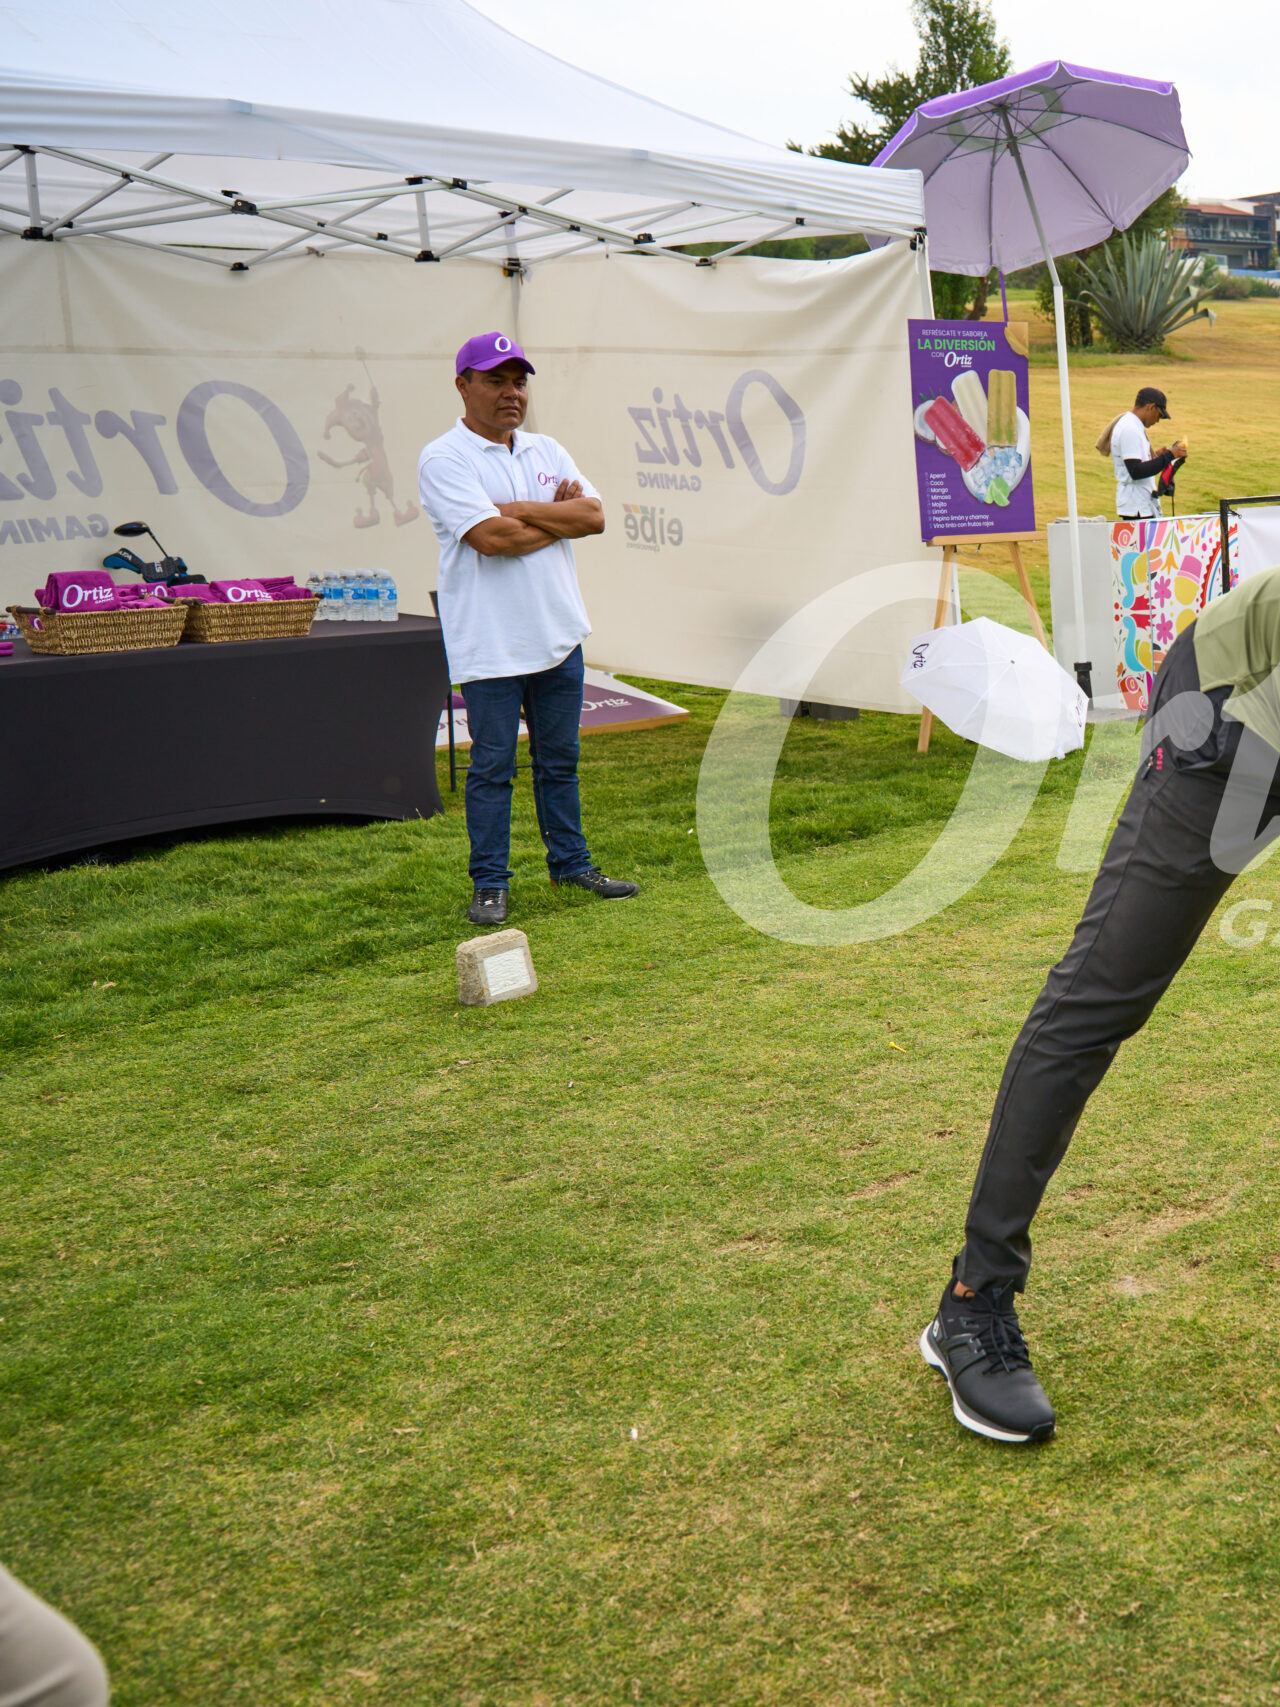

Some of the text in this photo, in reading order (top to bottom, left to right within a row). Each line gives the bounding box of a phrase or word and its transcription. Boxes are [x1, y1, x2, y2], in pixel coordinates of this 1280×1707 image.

[495, 336, 511, 352] O
[917, 337, 996, 351] LA DIVERSIÓN
[944, 351, 972, 367] Ortiz
[62, 584, 113, 608] Ortiz
